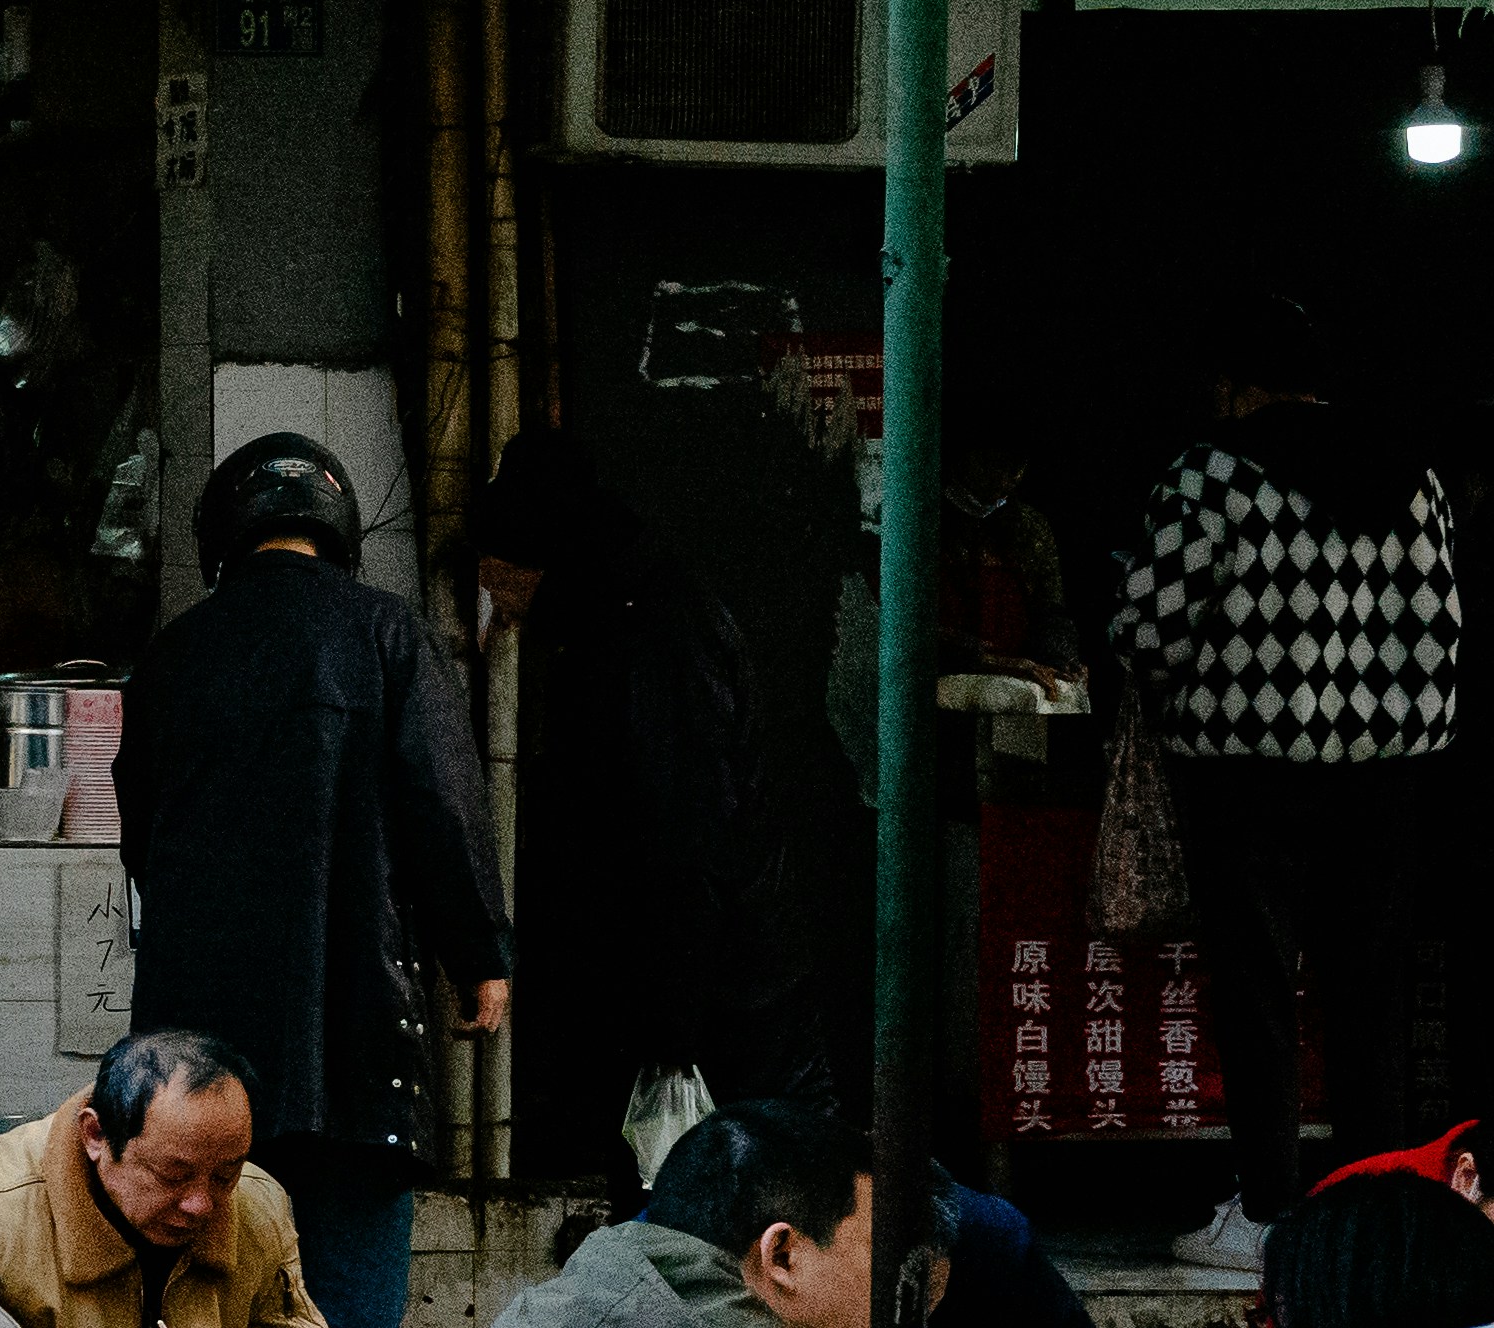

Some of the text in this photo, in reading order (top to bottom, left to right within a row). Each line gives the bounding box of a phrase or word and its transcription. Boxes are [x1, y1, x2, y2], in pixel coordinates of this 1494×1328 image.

[239, 7, 270, 47] 91
[1011, 940, 1053, 1132] 原味白馒头
[1084, 940, 1127, 1130] 层次甜馒头
